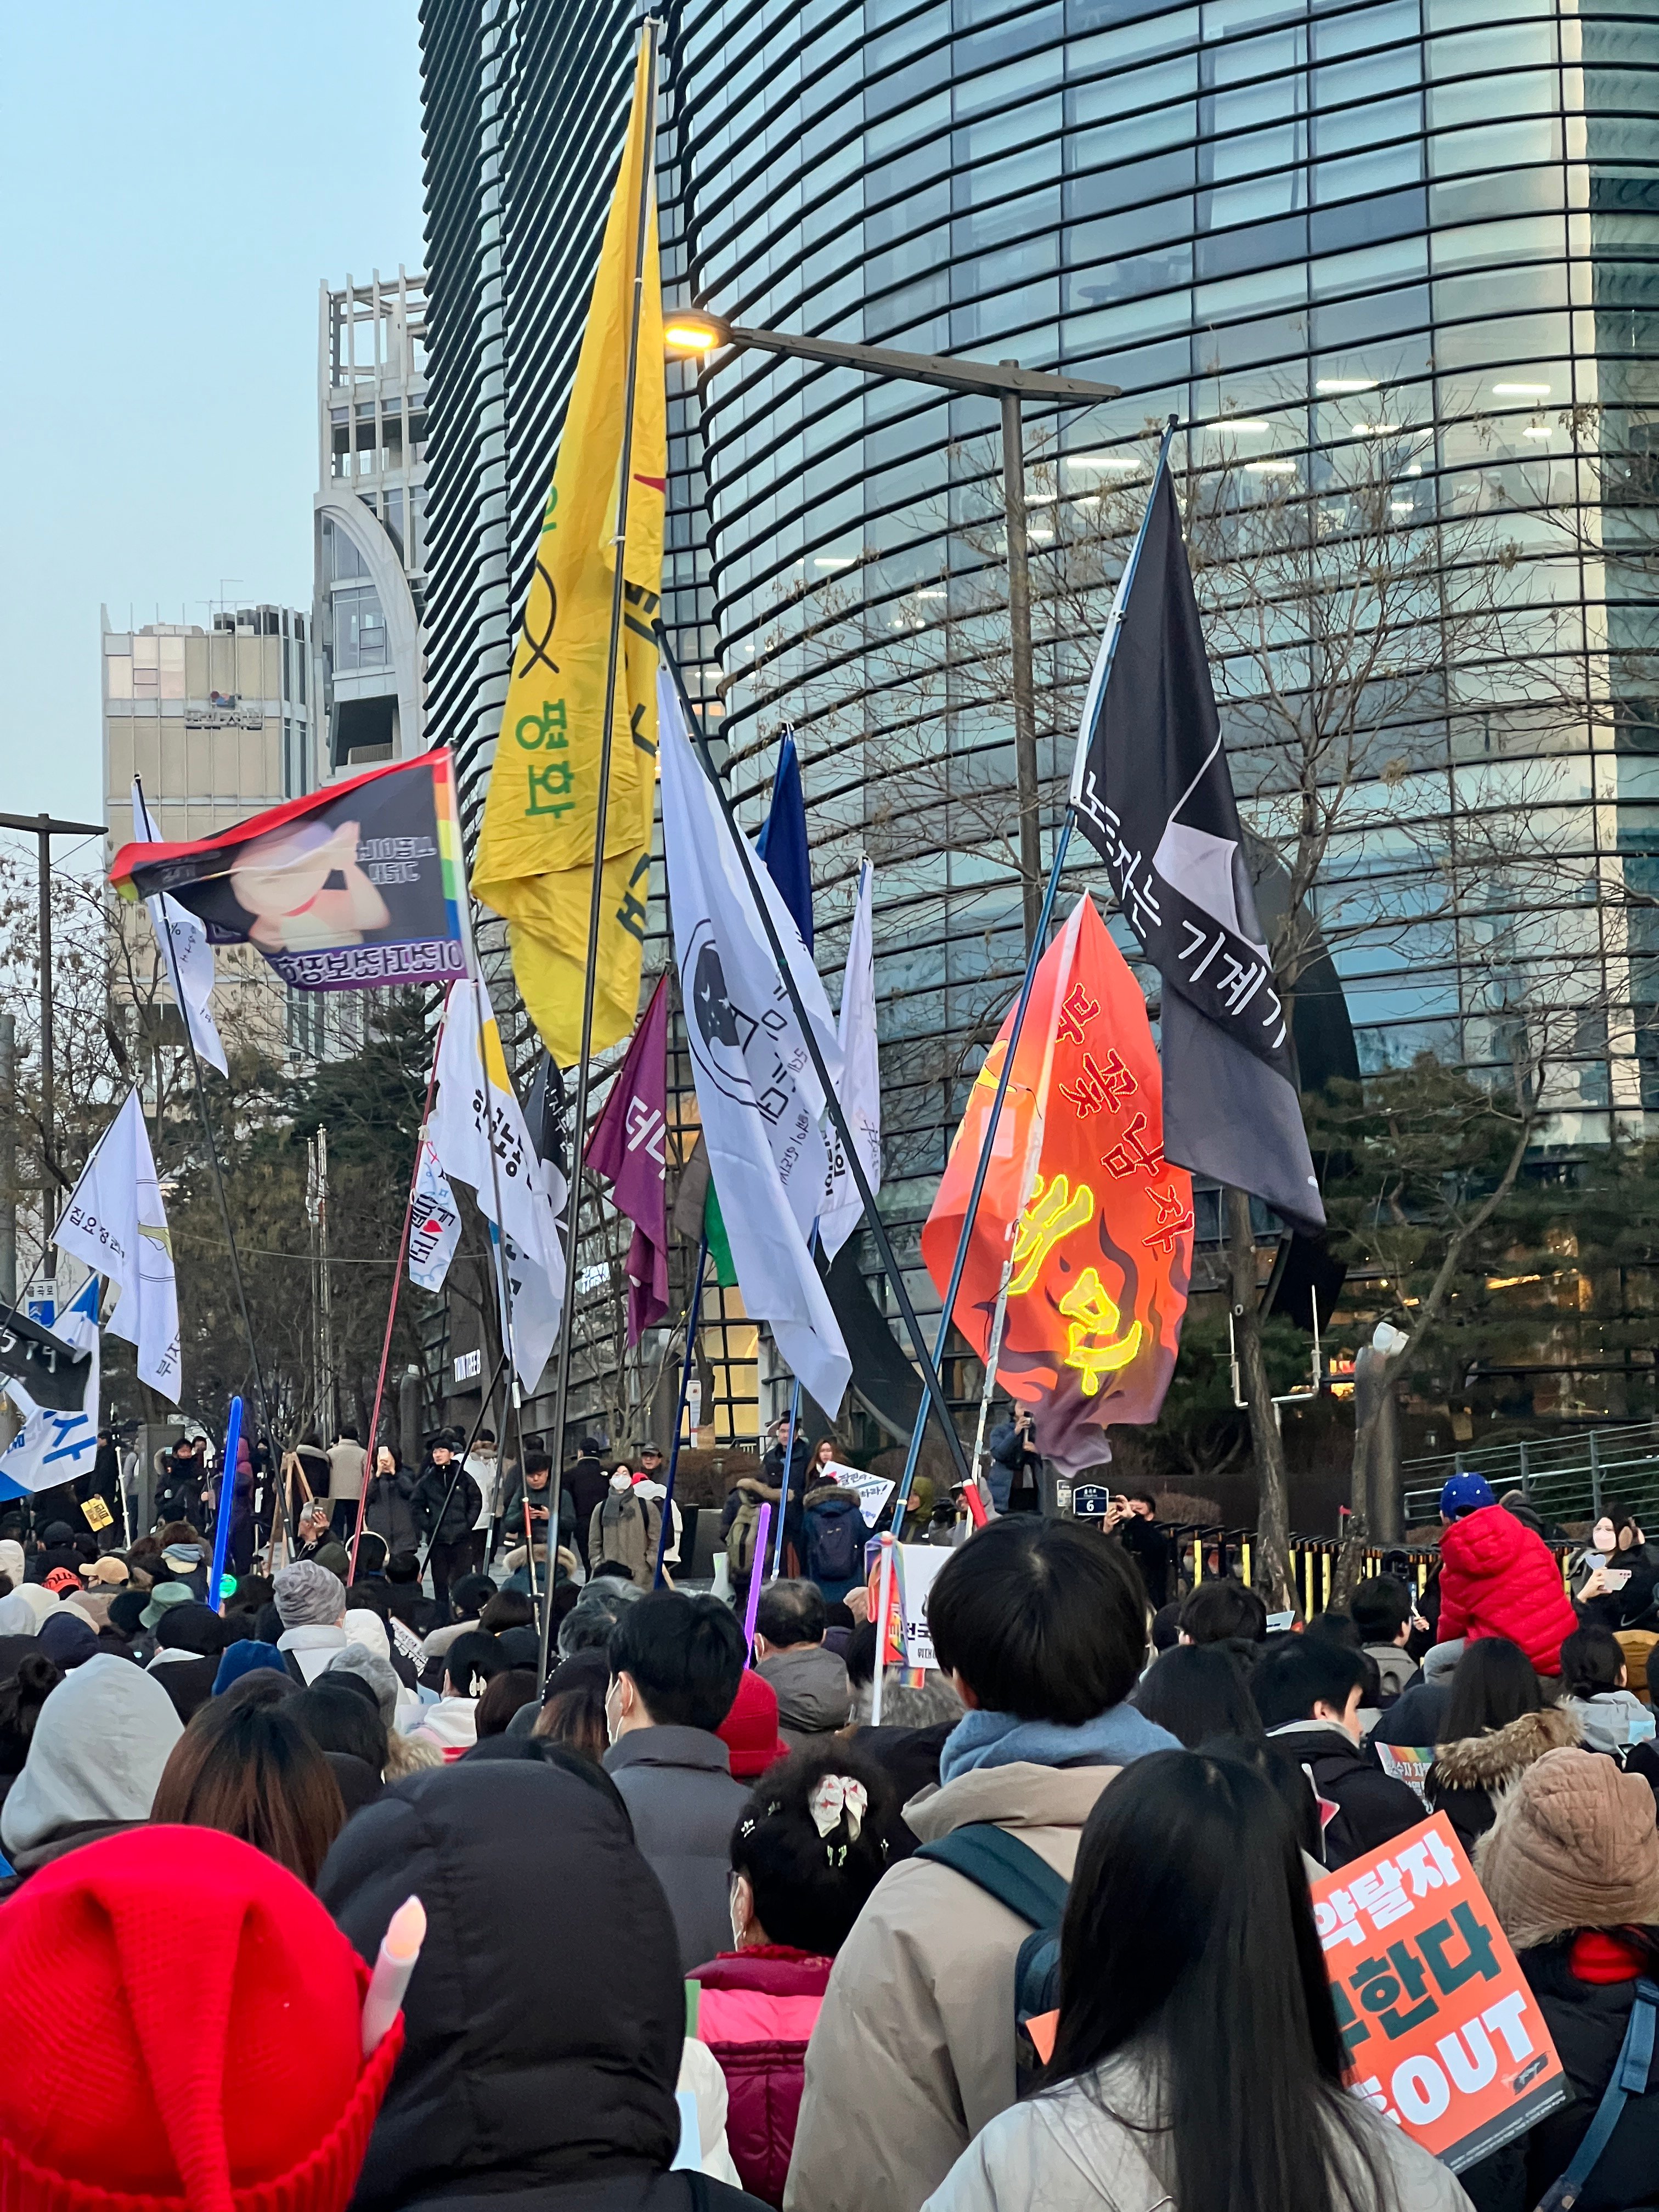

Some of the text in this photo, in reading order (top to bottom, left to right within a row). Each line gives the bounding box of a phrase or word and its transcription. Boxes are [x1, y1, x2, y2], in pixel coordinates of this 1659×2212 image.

[516, 698, 575, 819] 평화
[1086, 1500, 1094, 1512] 6
[1330, 1899, 1502, 2064] 한다
